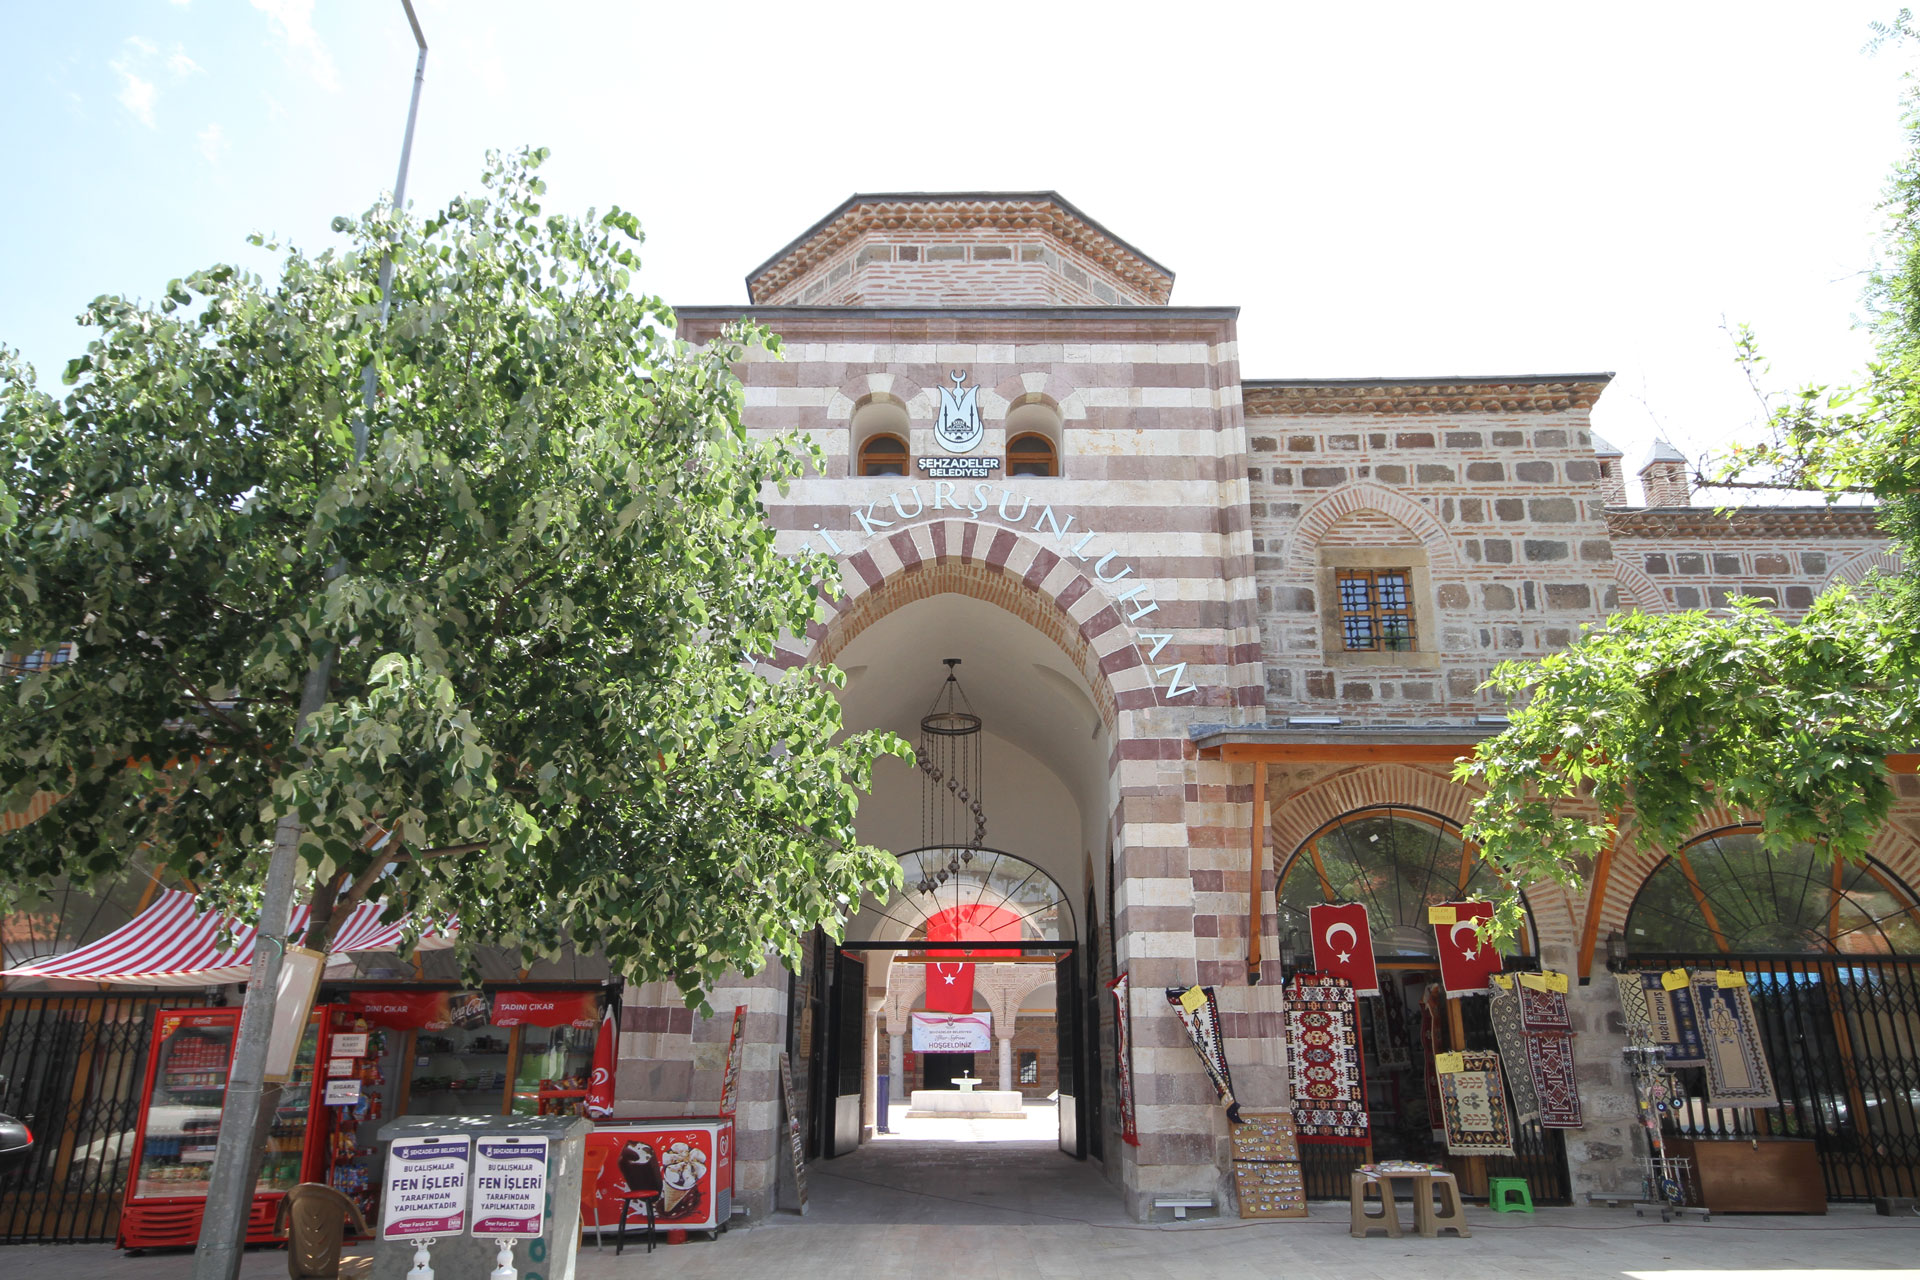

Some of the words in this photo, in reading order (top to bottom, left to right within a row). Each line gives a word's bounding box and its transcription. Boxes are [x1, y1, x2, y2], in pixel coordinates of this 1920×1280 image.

[918, 458, 999, 470] ŞEHZADELER
[929, 468, 988, 477] BELEDİYESİ
[501, 1003, 527, 1011] TADINI
[529, 1003, 554, 1012] ÇIKAR
[404, 1165, 413, 1173] BU
[414, 1163, 455, 1173] ÇALIŞMALAR
[497, 1164, 533, 1172] ÇALIŞMALAR
[392, 1177, 418, 1191] FEN
[422, 1172, 464, 1191] İŞLERİ
[479, 1177, 501, 1189] FEN
[504, 1174, 542, 1191] İŞLERİ
[400, 1192, 451, 1202] TARAFINDAN
[486, 1193, 530, 1201] TARAFINDAN
[394, 1201, 457, 1212] YAPILMAKTADIR
